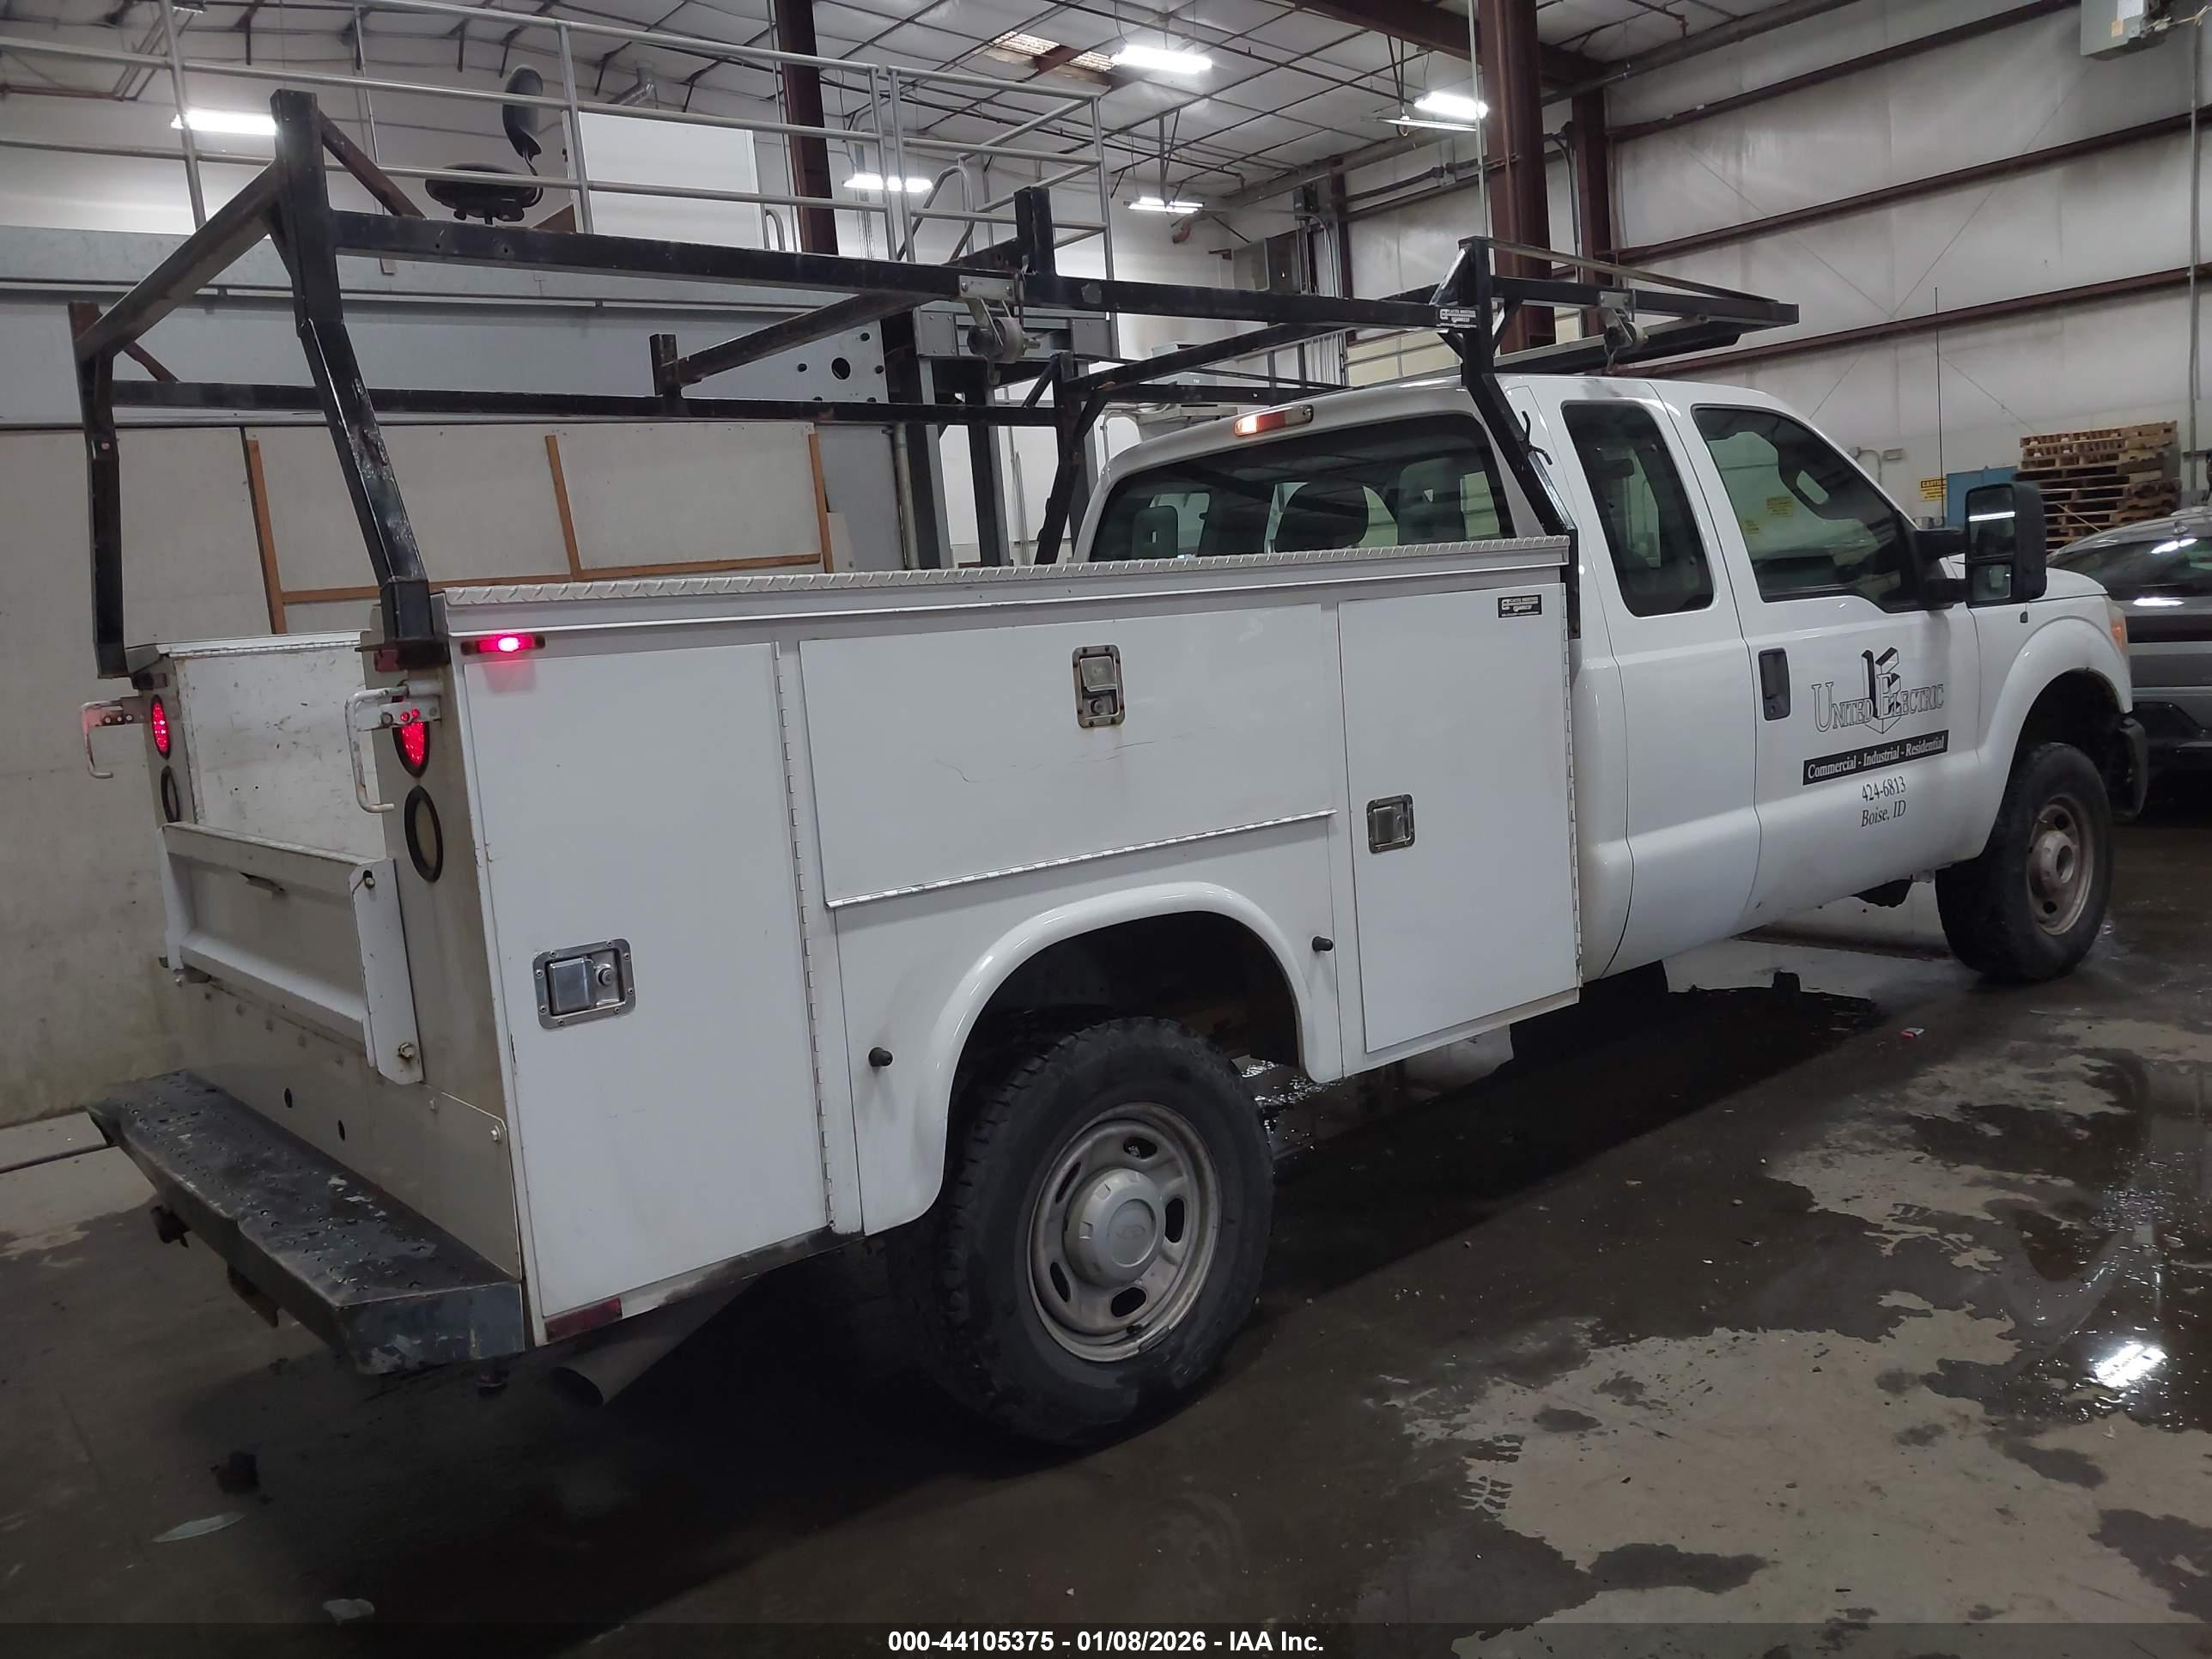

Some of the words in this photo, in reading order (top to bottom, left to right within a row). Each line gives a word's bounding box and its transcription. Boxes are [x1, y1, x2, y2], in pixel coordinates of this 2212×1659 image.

[1811, 682, 1873, 732] UNITED
[1876, 673, 1944, 720] ELECTRIC
[1808, 758, 1856, 779] Commercial
[1863, 747, 1899, 766] Industrial
[1905, 736, 1945, 757] Residential
[1862, 776, 1906, 802] 424-6813
[1893, 799, 1906, 817] ID
